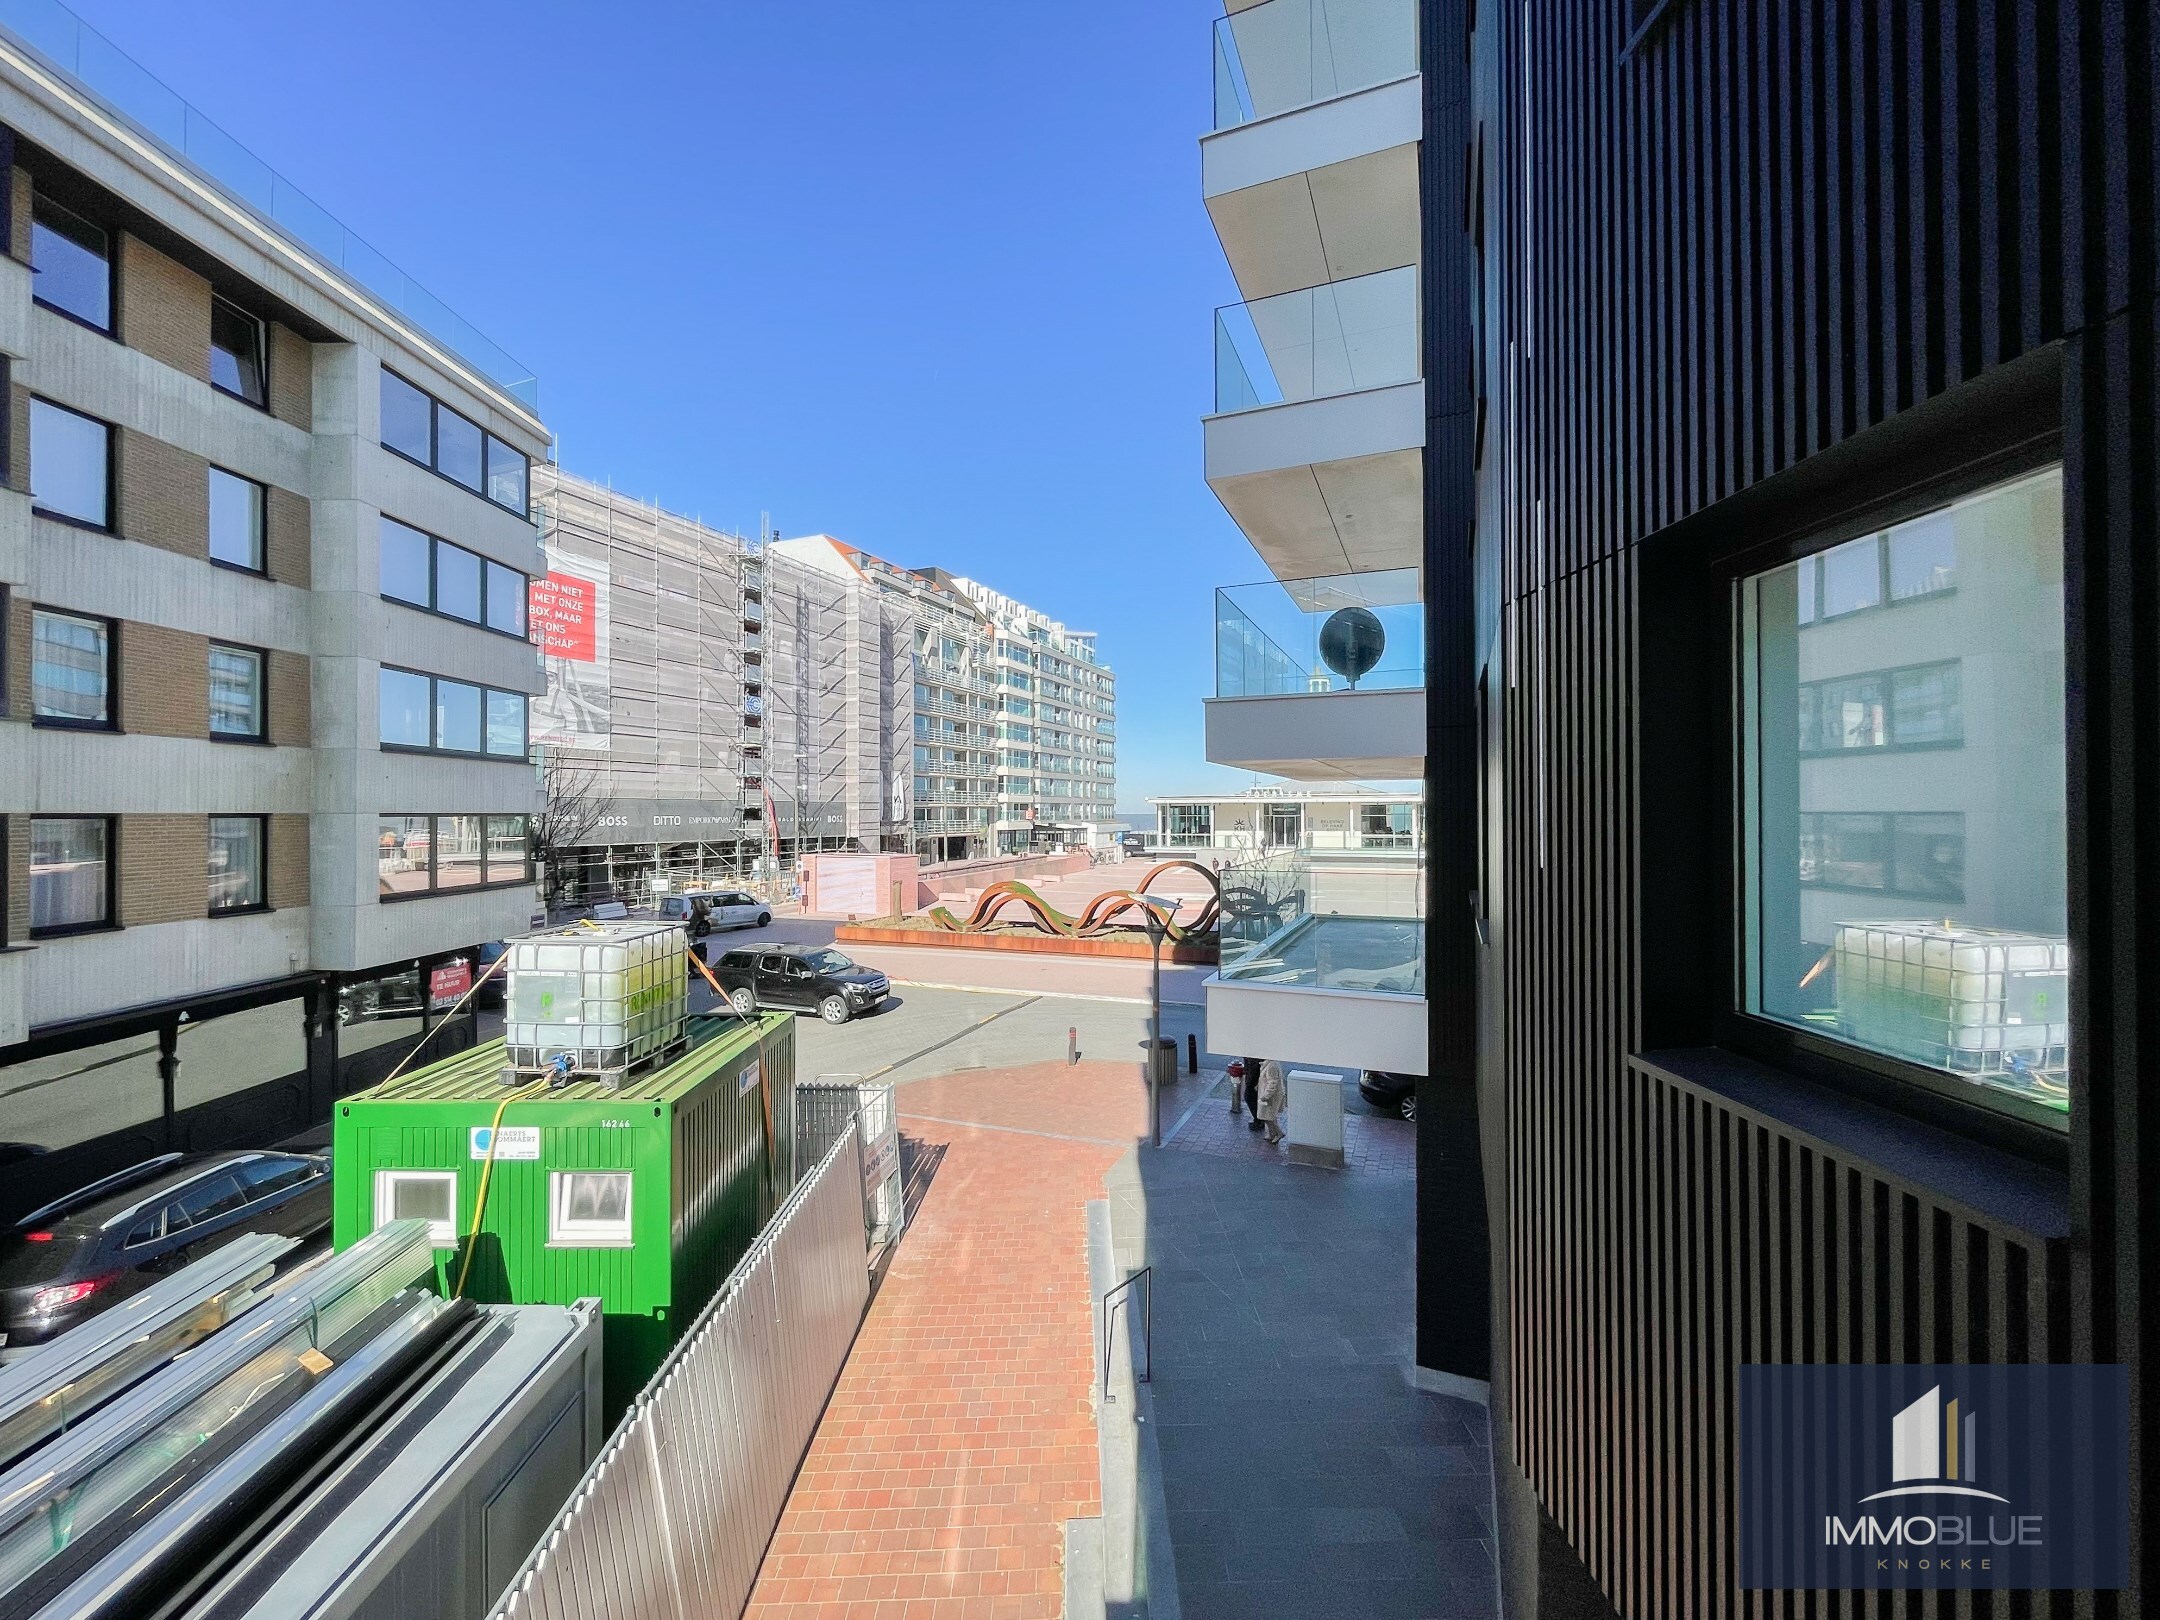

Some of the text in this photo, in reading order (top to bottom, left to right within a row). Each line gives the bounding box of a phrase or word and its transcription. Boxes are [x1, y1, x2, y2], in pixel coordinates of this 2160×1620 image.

[561, 585, 584, 598] NIET
[534, 592, 584, 611] MET ONZE
[555, 610, 582, 624] MAAR
[545, 622, 566, 633] ONS
[1245, 790, 1311, 798] TOERISME
[598, 816, 628, 827] BOSS
[653, 815, 681, 826] DITTO
[827, 815, 843, 823] BOSS
